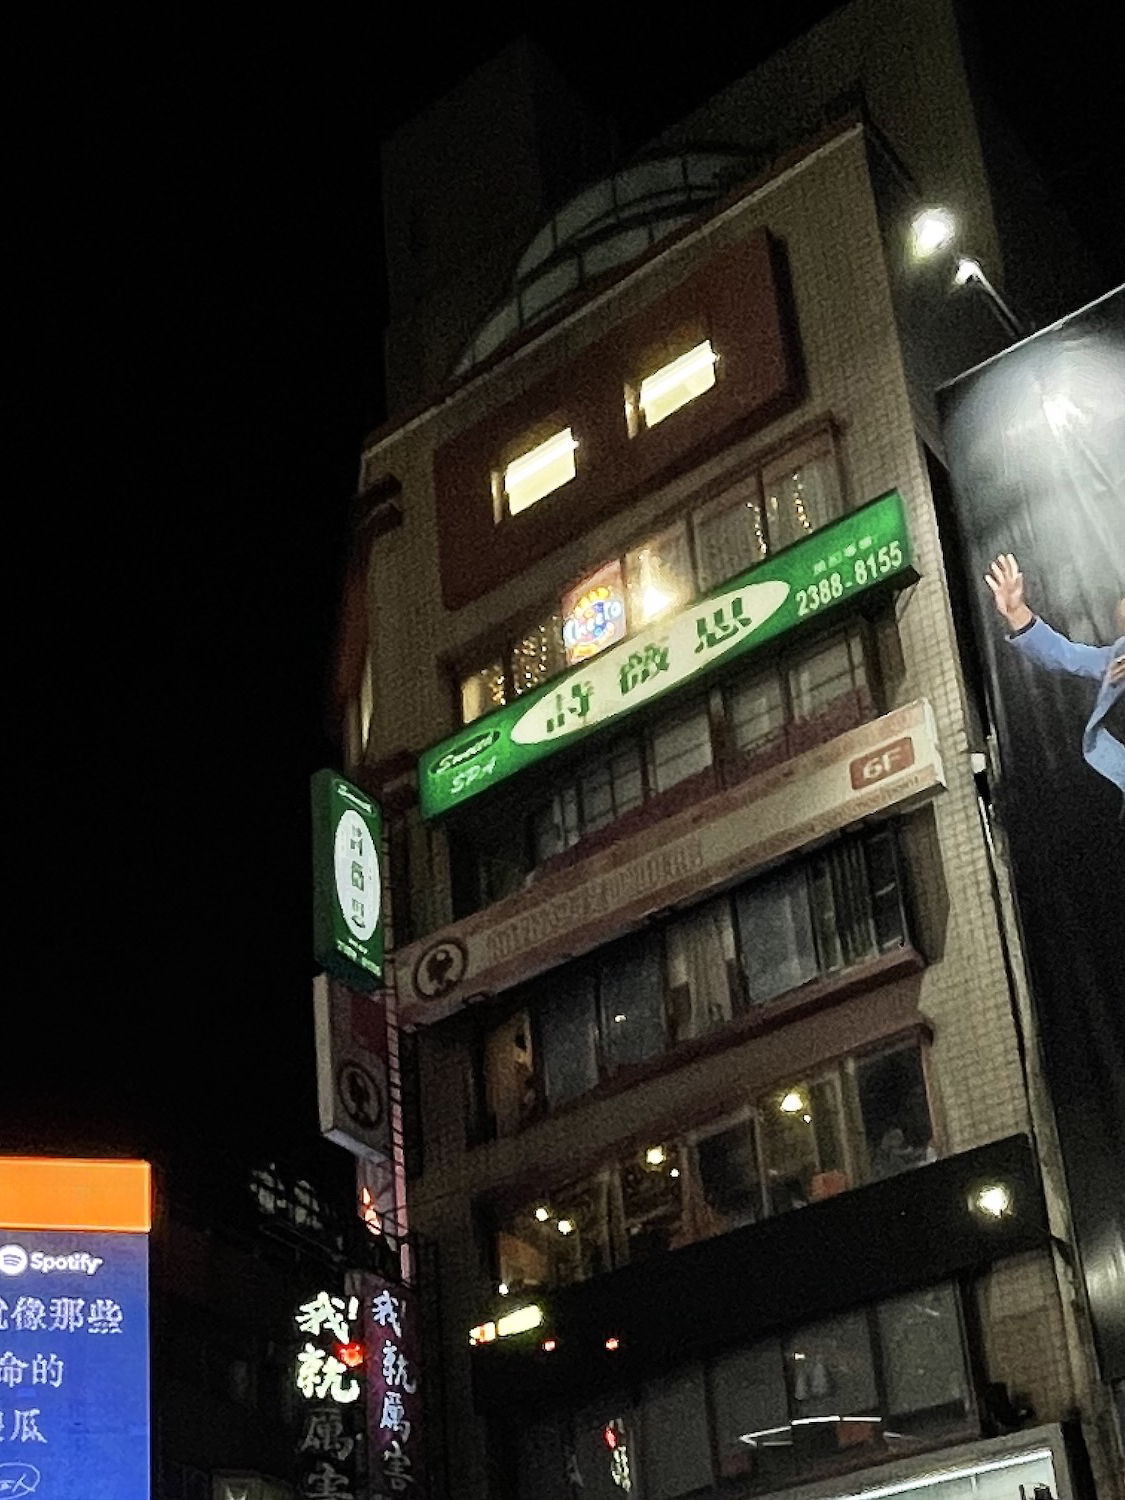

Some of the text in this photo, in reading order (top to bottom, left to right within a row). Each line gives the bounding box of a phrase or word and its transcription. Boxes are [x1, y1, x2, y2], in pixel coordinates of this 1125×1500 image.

[795, 540, 902, 617] 2388-8155
[862, 747, 902, 780] 6F
[30, 1251, 103, 1276] Spotify
